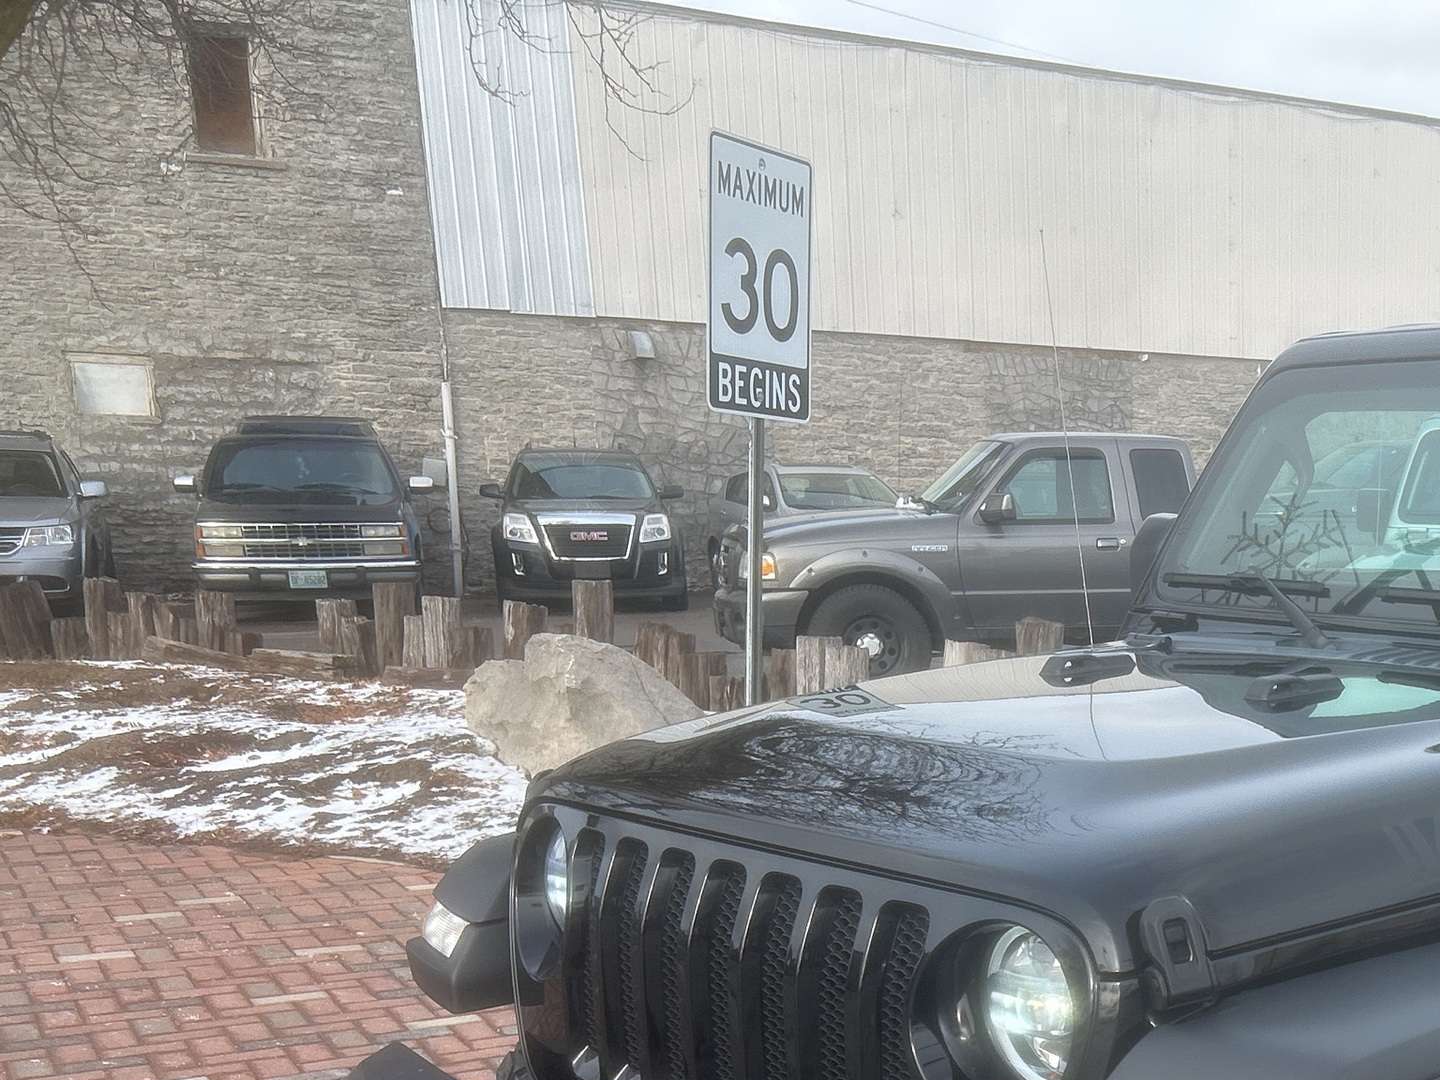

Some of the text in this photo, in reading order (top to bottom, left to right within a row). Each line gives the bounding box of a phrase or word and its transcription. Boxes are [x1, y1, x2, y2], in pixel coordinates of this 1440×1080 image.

[717, 160, 804, 218] MAXIMUM
[721, 236, 799, 343] 30
[718, 361, 801, 412] BEGINS
[570, 531, 608, 541] GMC
